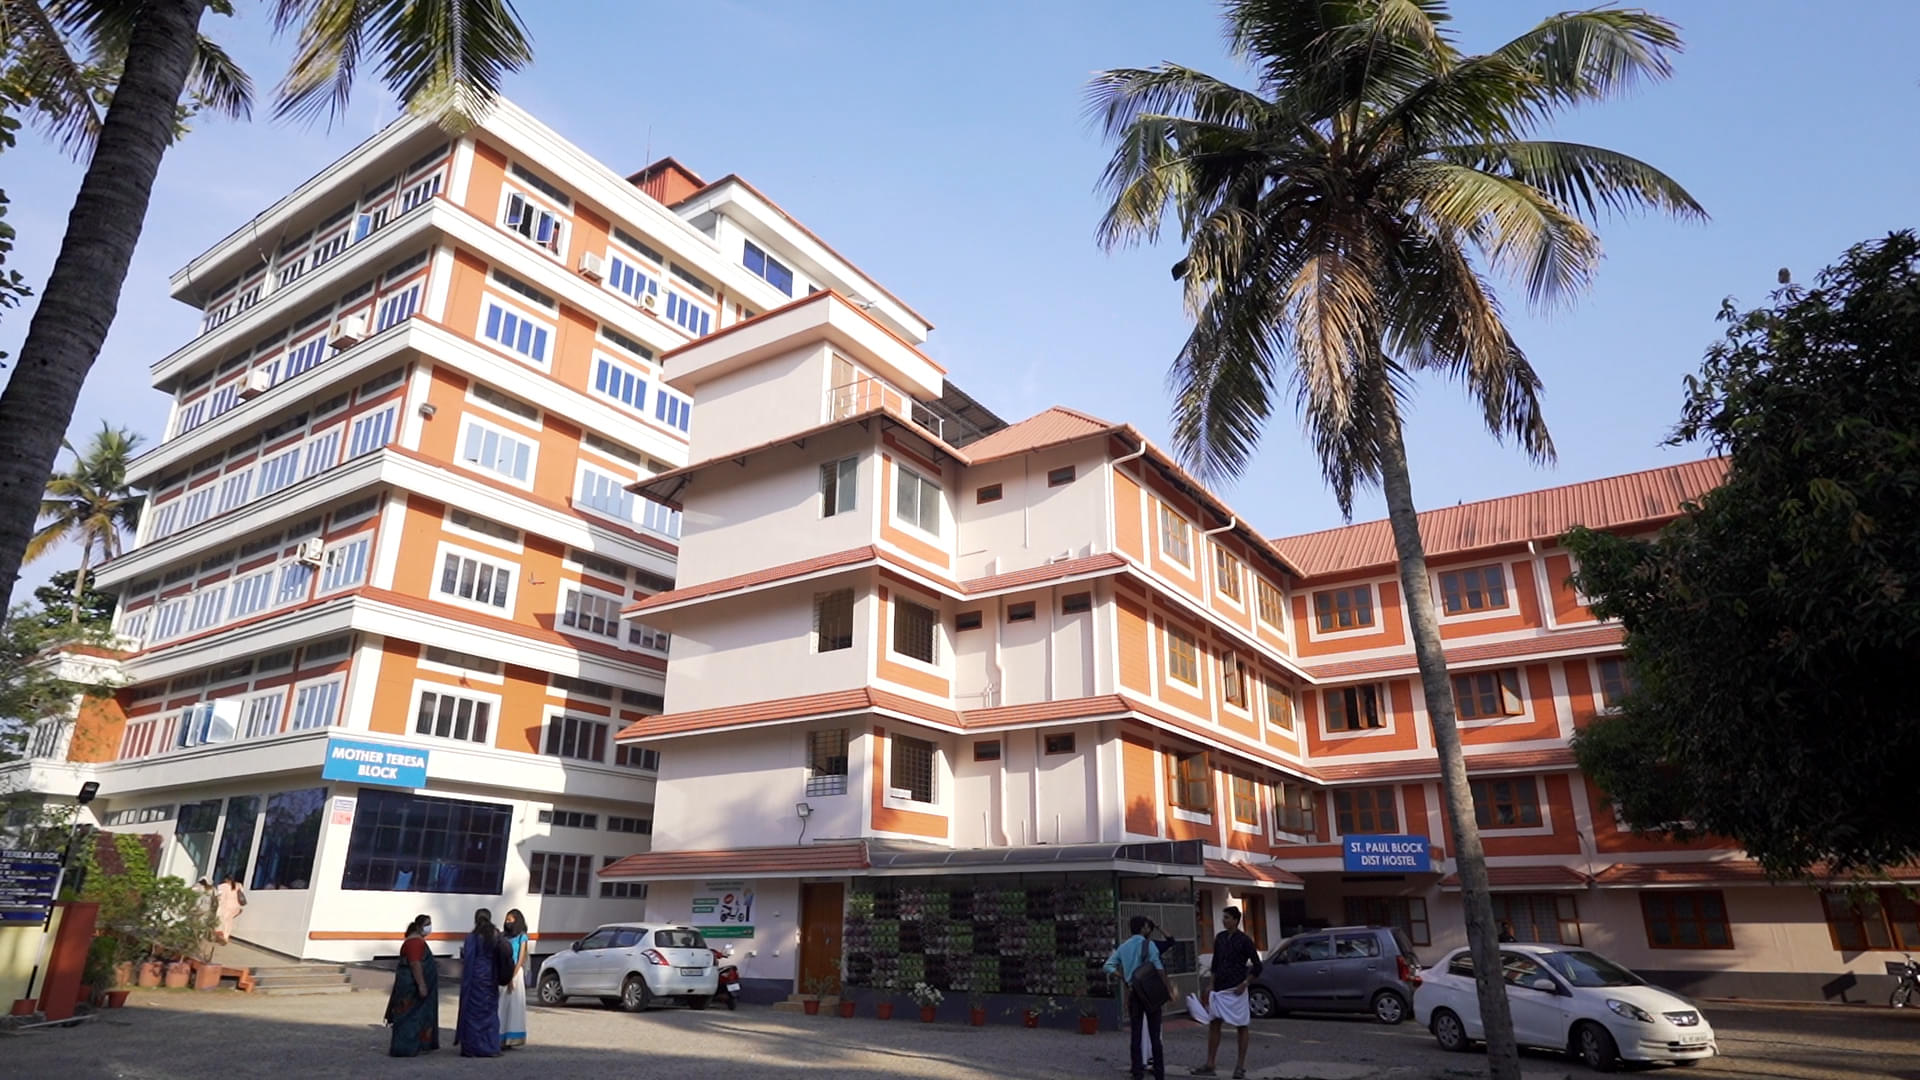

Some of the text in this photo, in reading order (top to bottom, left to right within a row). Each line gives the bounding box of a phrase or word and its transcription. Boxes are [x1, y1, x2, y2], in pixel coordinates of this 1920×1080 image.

[332, 747, 425, 768] MOTHER TERESA
[358, 764, 398, 779] BLOCK
[1351, 842, 1423, 853] ST. PAUL BLOCK
[1361, 855, 1416, 866] DIST HOSTEL
